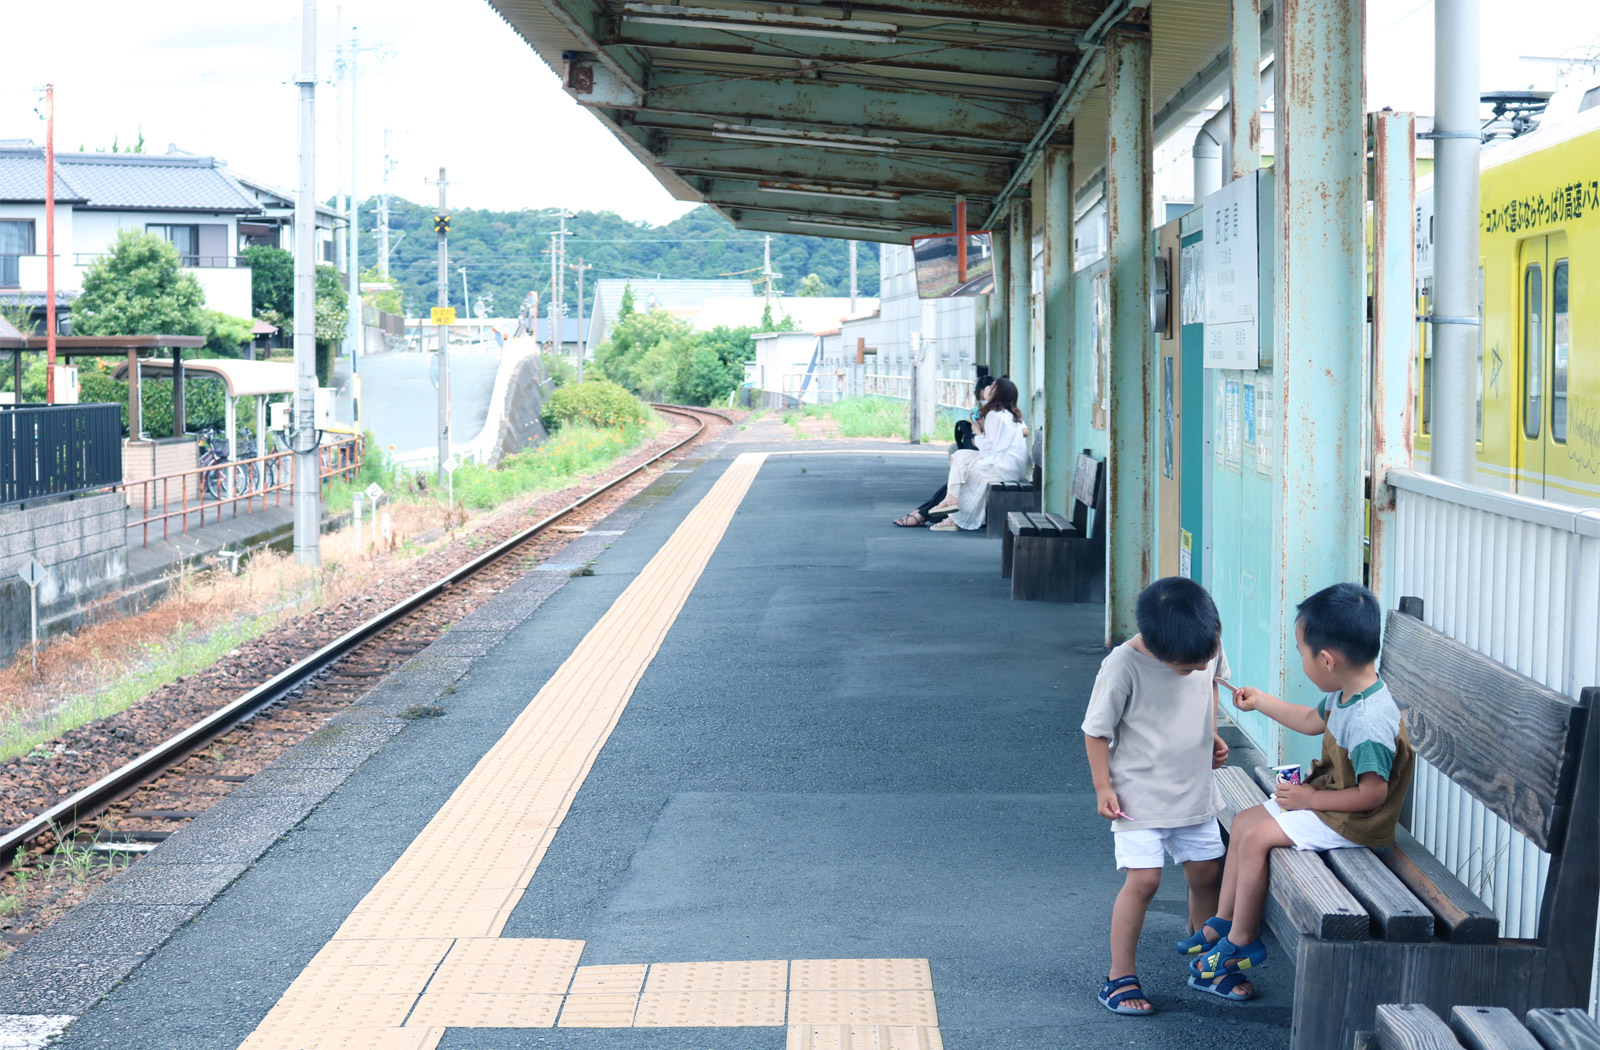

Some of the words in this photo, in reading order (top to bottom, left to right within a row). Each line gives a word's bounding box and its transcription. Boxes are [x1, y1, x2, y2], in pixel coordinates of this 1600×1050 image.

[1486, 180, 1599, 233] コスパで選ぶならやっぱり高速バス
[370, 486, 378, 497] 2
[1211, 951, 1221, 972] adidas
